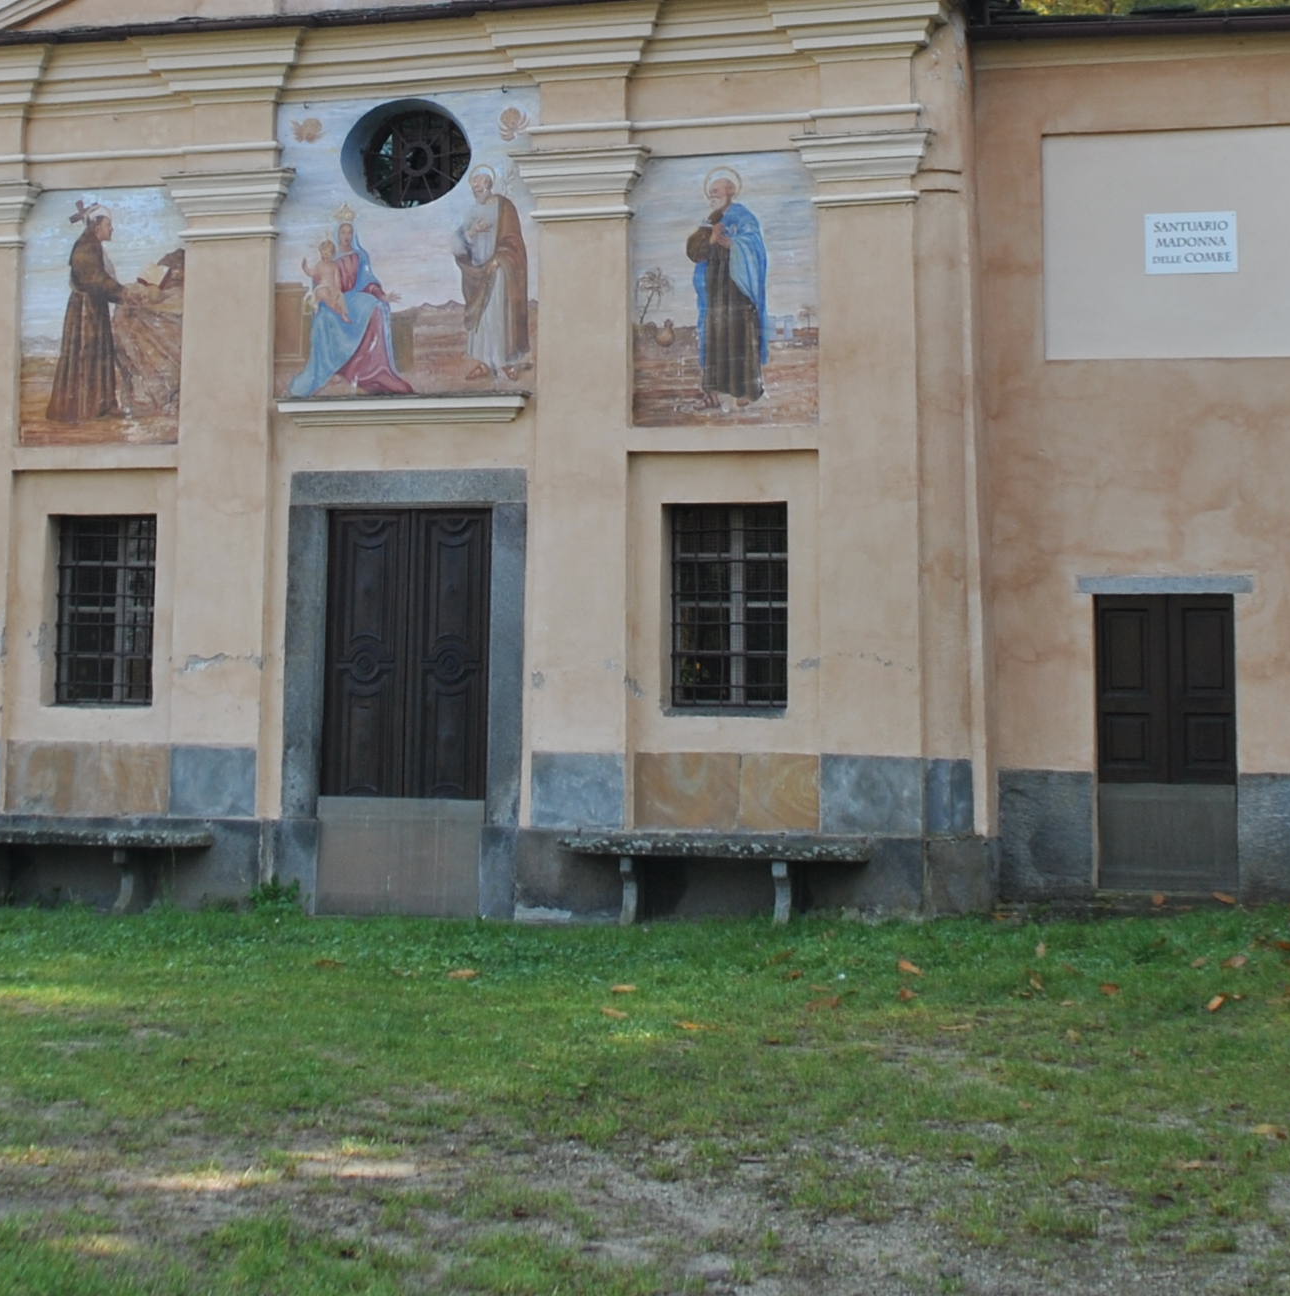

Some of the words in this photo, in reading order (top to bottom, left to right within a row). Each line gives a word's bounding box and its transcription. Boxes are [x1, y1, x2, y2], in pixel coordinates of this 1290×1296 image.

[1153, 220, 1229, 233] SANTUARIO
[1155, 236, 1227, 248] MADONNA
[1152, 255, 1182, 264] DELLE
[1183, 251, 1232, 264] COMBE
